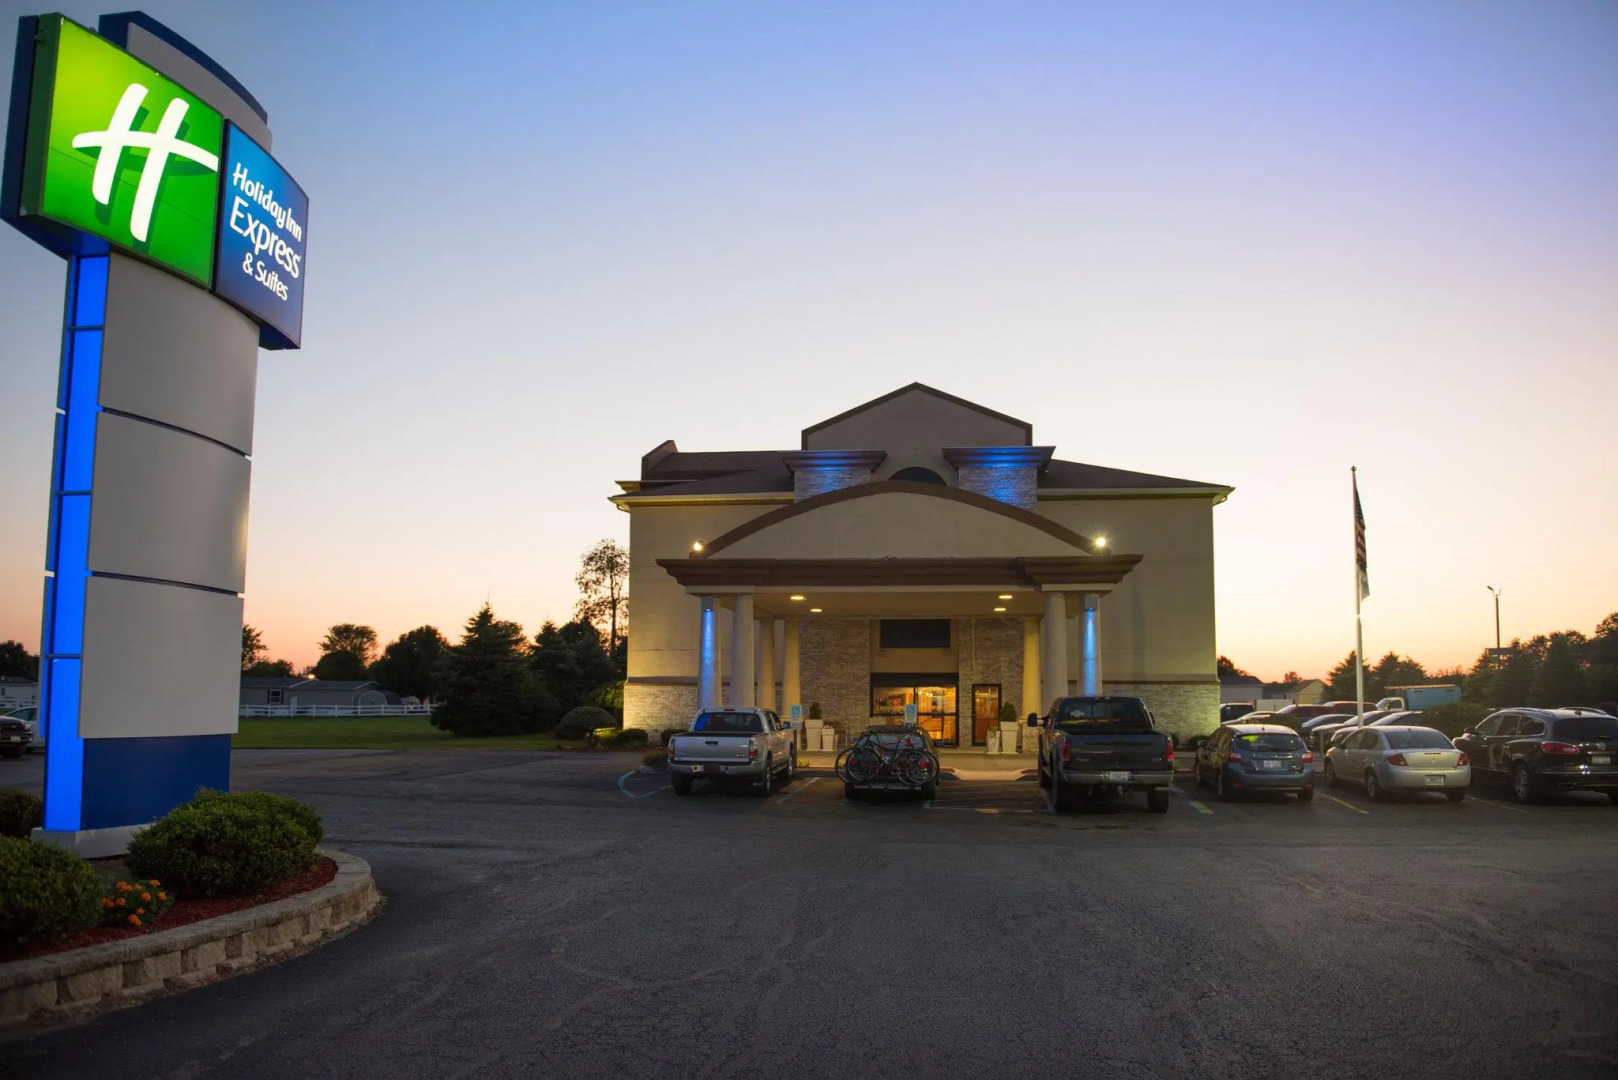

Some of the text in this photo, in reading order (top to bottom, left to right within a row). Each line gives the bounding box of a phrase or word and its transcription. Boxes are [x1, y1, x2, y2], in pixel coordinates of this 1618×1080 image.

[72, 83, 218, 242] H
[232, 162, 303, 242] Holiday Inn
[230, 195, 300, 279] Express
[242, 252, 289, 301] & Suites
